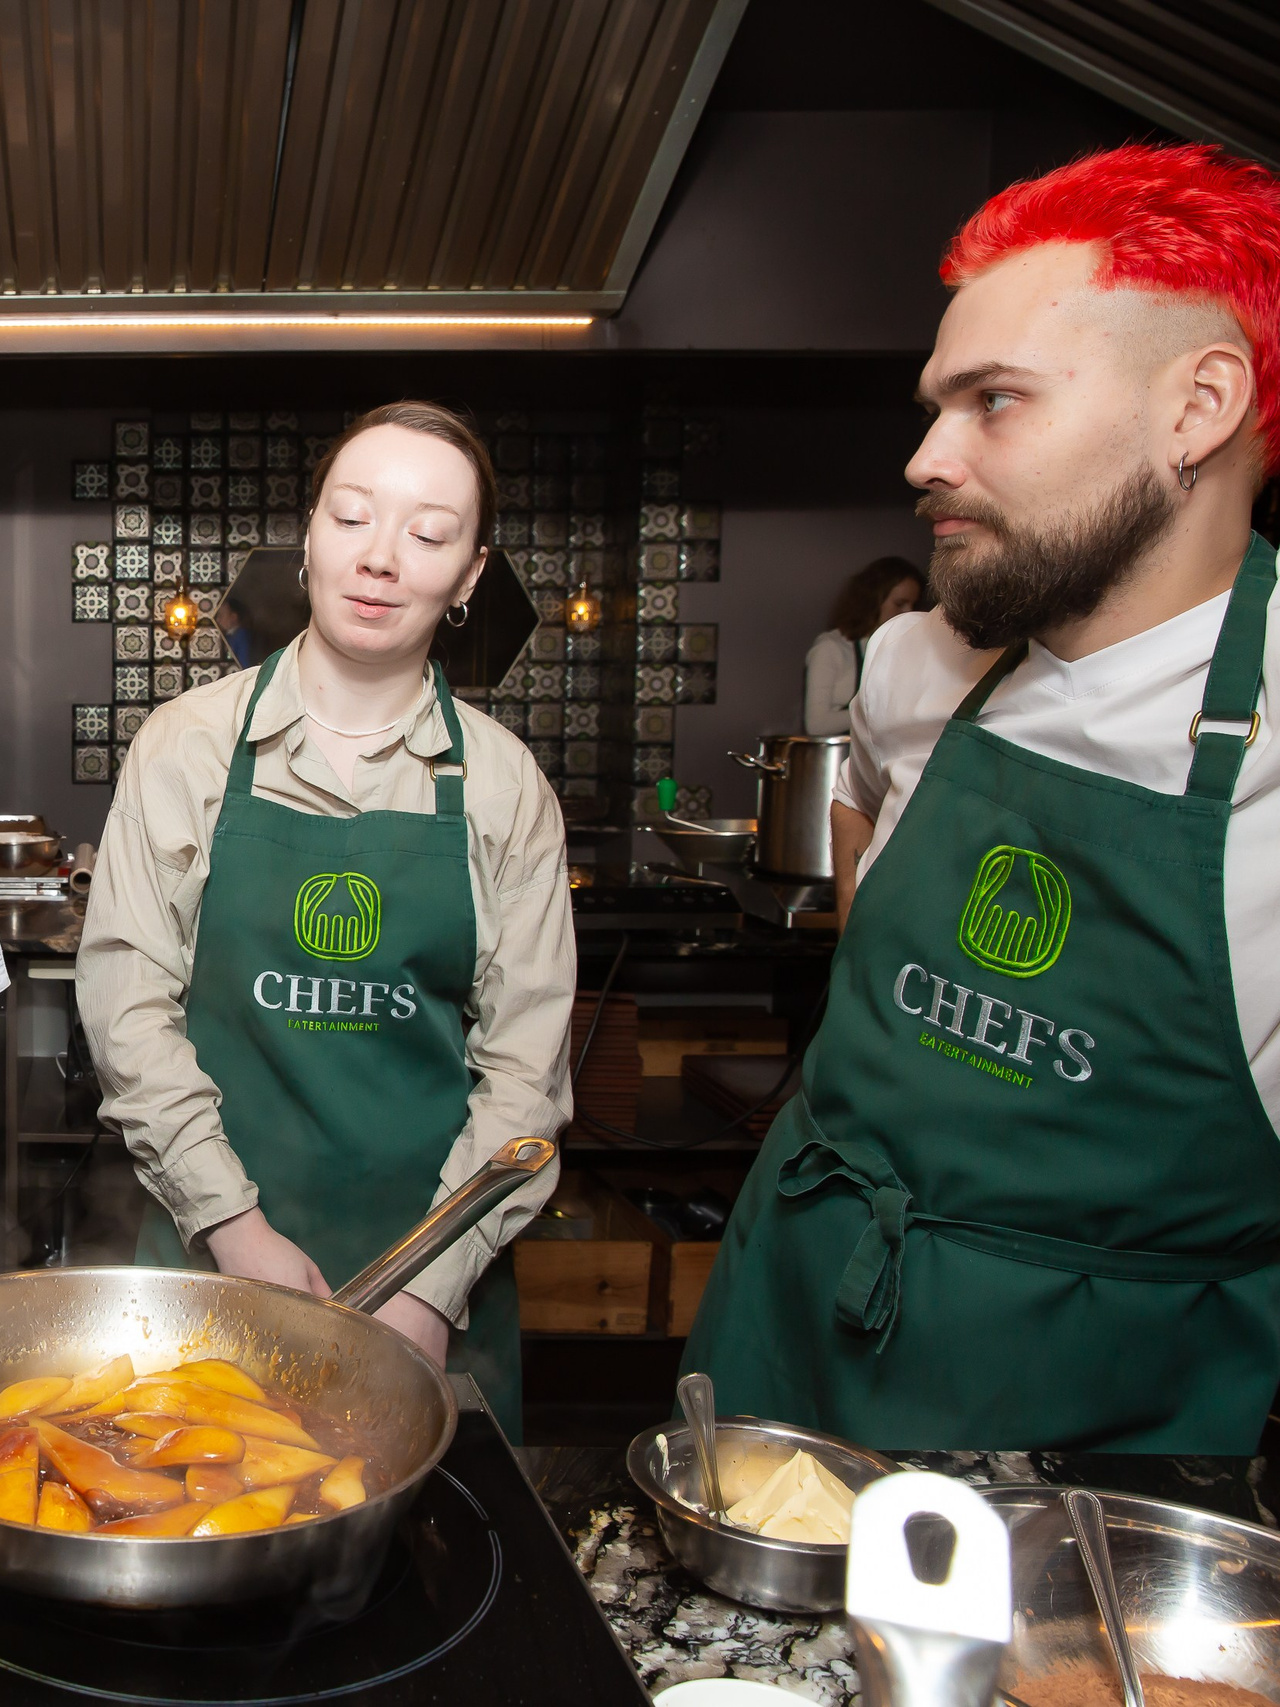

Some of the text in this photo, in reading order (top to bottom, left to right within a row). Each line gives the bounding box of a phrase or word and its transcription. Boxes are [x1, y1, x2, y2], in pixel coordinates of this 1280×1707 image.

[253, 970, 417, 1019] CHEFS
[893, 963, 1095, 1082] CHEFS
[919, 1031, 1034, 1089] EATERTAINMENT
